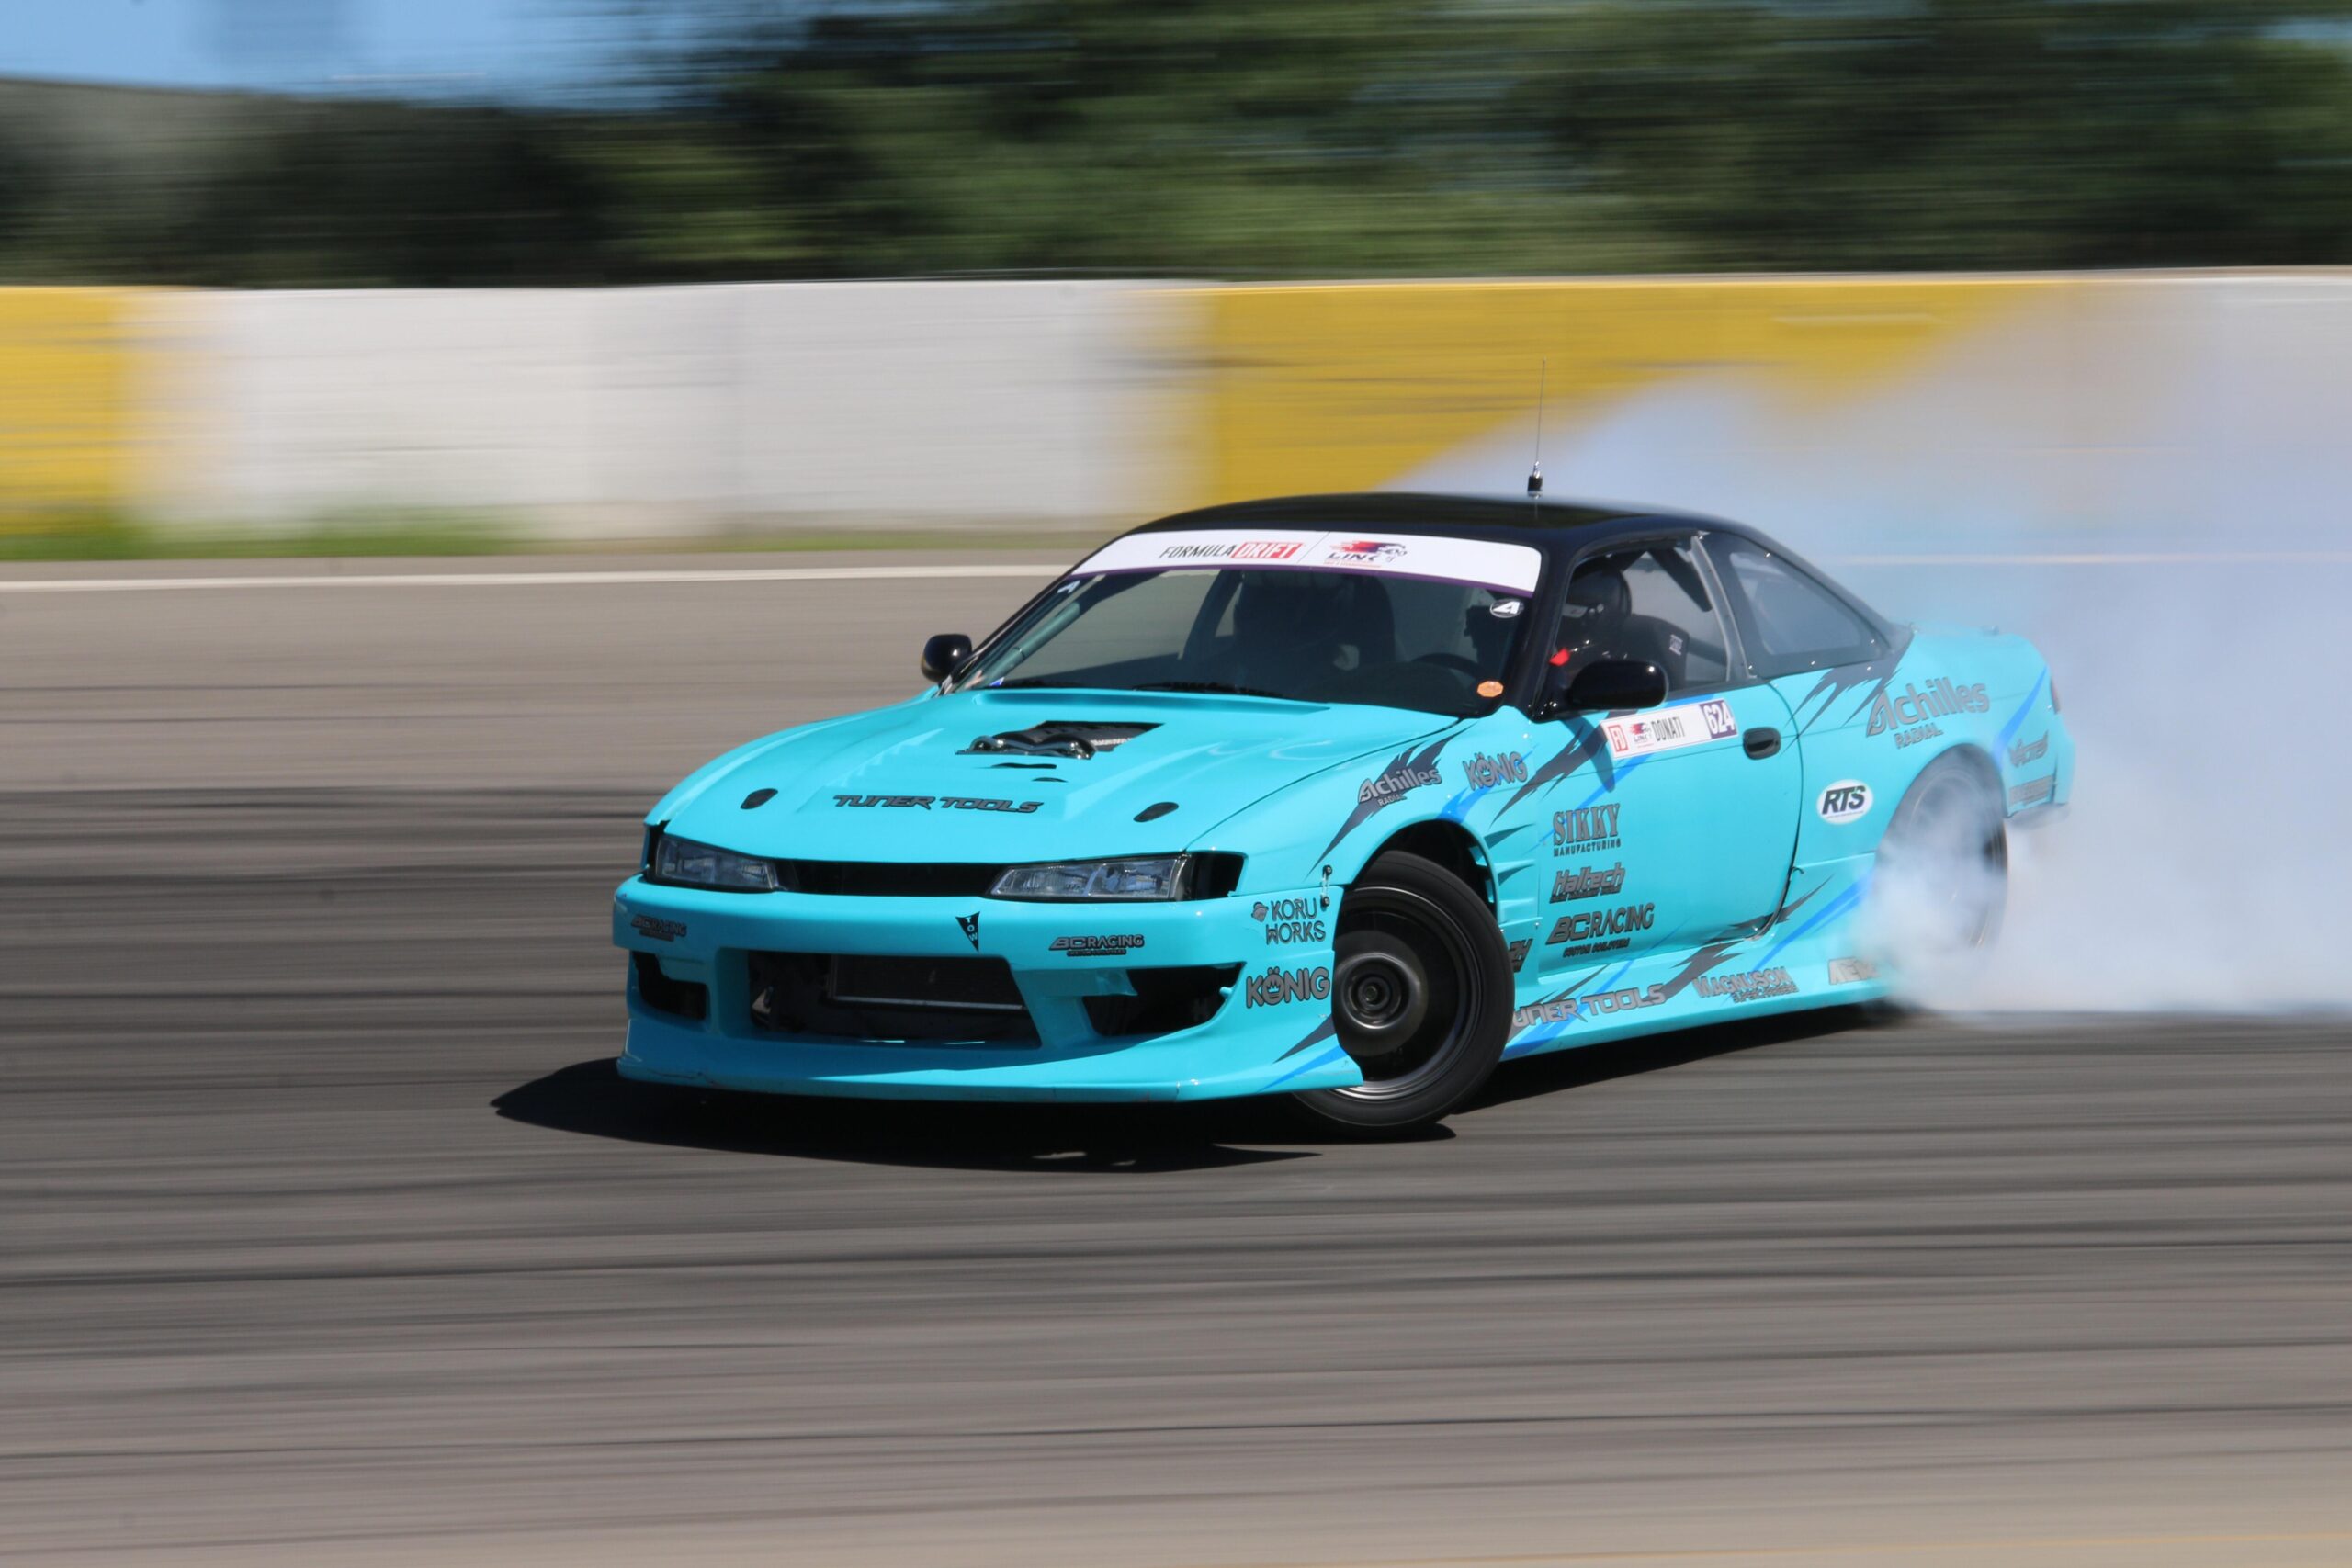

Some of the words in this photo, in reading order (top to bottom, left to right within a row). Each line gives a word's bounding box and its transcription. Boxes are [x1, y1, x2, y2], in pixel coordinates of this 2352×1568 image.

[1158, 544, 1238, 559] FORMULA
[1229, 542, 1304, 558] DRIFT
[1703, 702, 1736, 735] 624
[1866, 676, 1990, 738] Achilles
[1650, 716, 1686, 742] DONATI
[1893, 722, 1944, 750] RADIAL
[1358, 767, 1442, 804] Achilles
[1463, 751, 1528, 791] KÖNIG
[832, 794, 936, 810] TUNER
[939, 796, 1045, 814] TOOLS
[1821, 785, 1867, 816] RTS
[1553, 803, 1621, 846] SIKKY
[1553, 838, 1622, 858] MANUFACTURING
[1553, 862, 1626, 897] Haltech
[1270, 897, 1318, 922] KORU
[965, 917, 978, 942] TOW
[1265, 920, 1326, 946] WORKS
[1246, 965, 1331, 1010] KÖNIG
[1692, 966, 1792, 999] MAGNUSON
[1512, 998, 1589, 1028] UNER
[1580, 982, 1667, 1016] TOOLS
